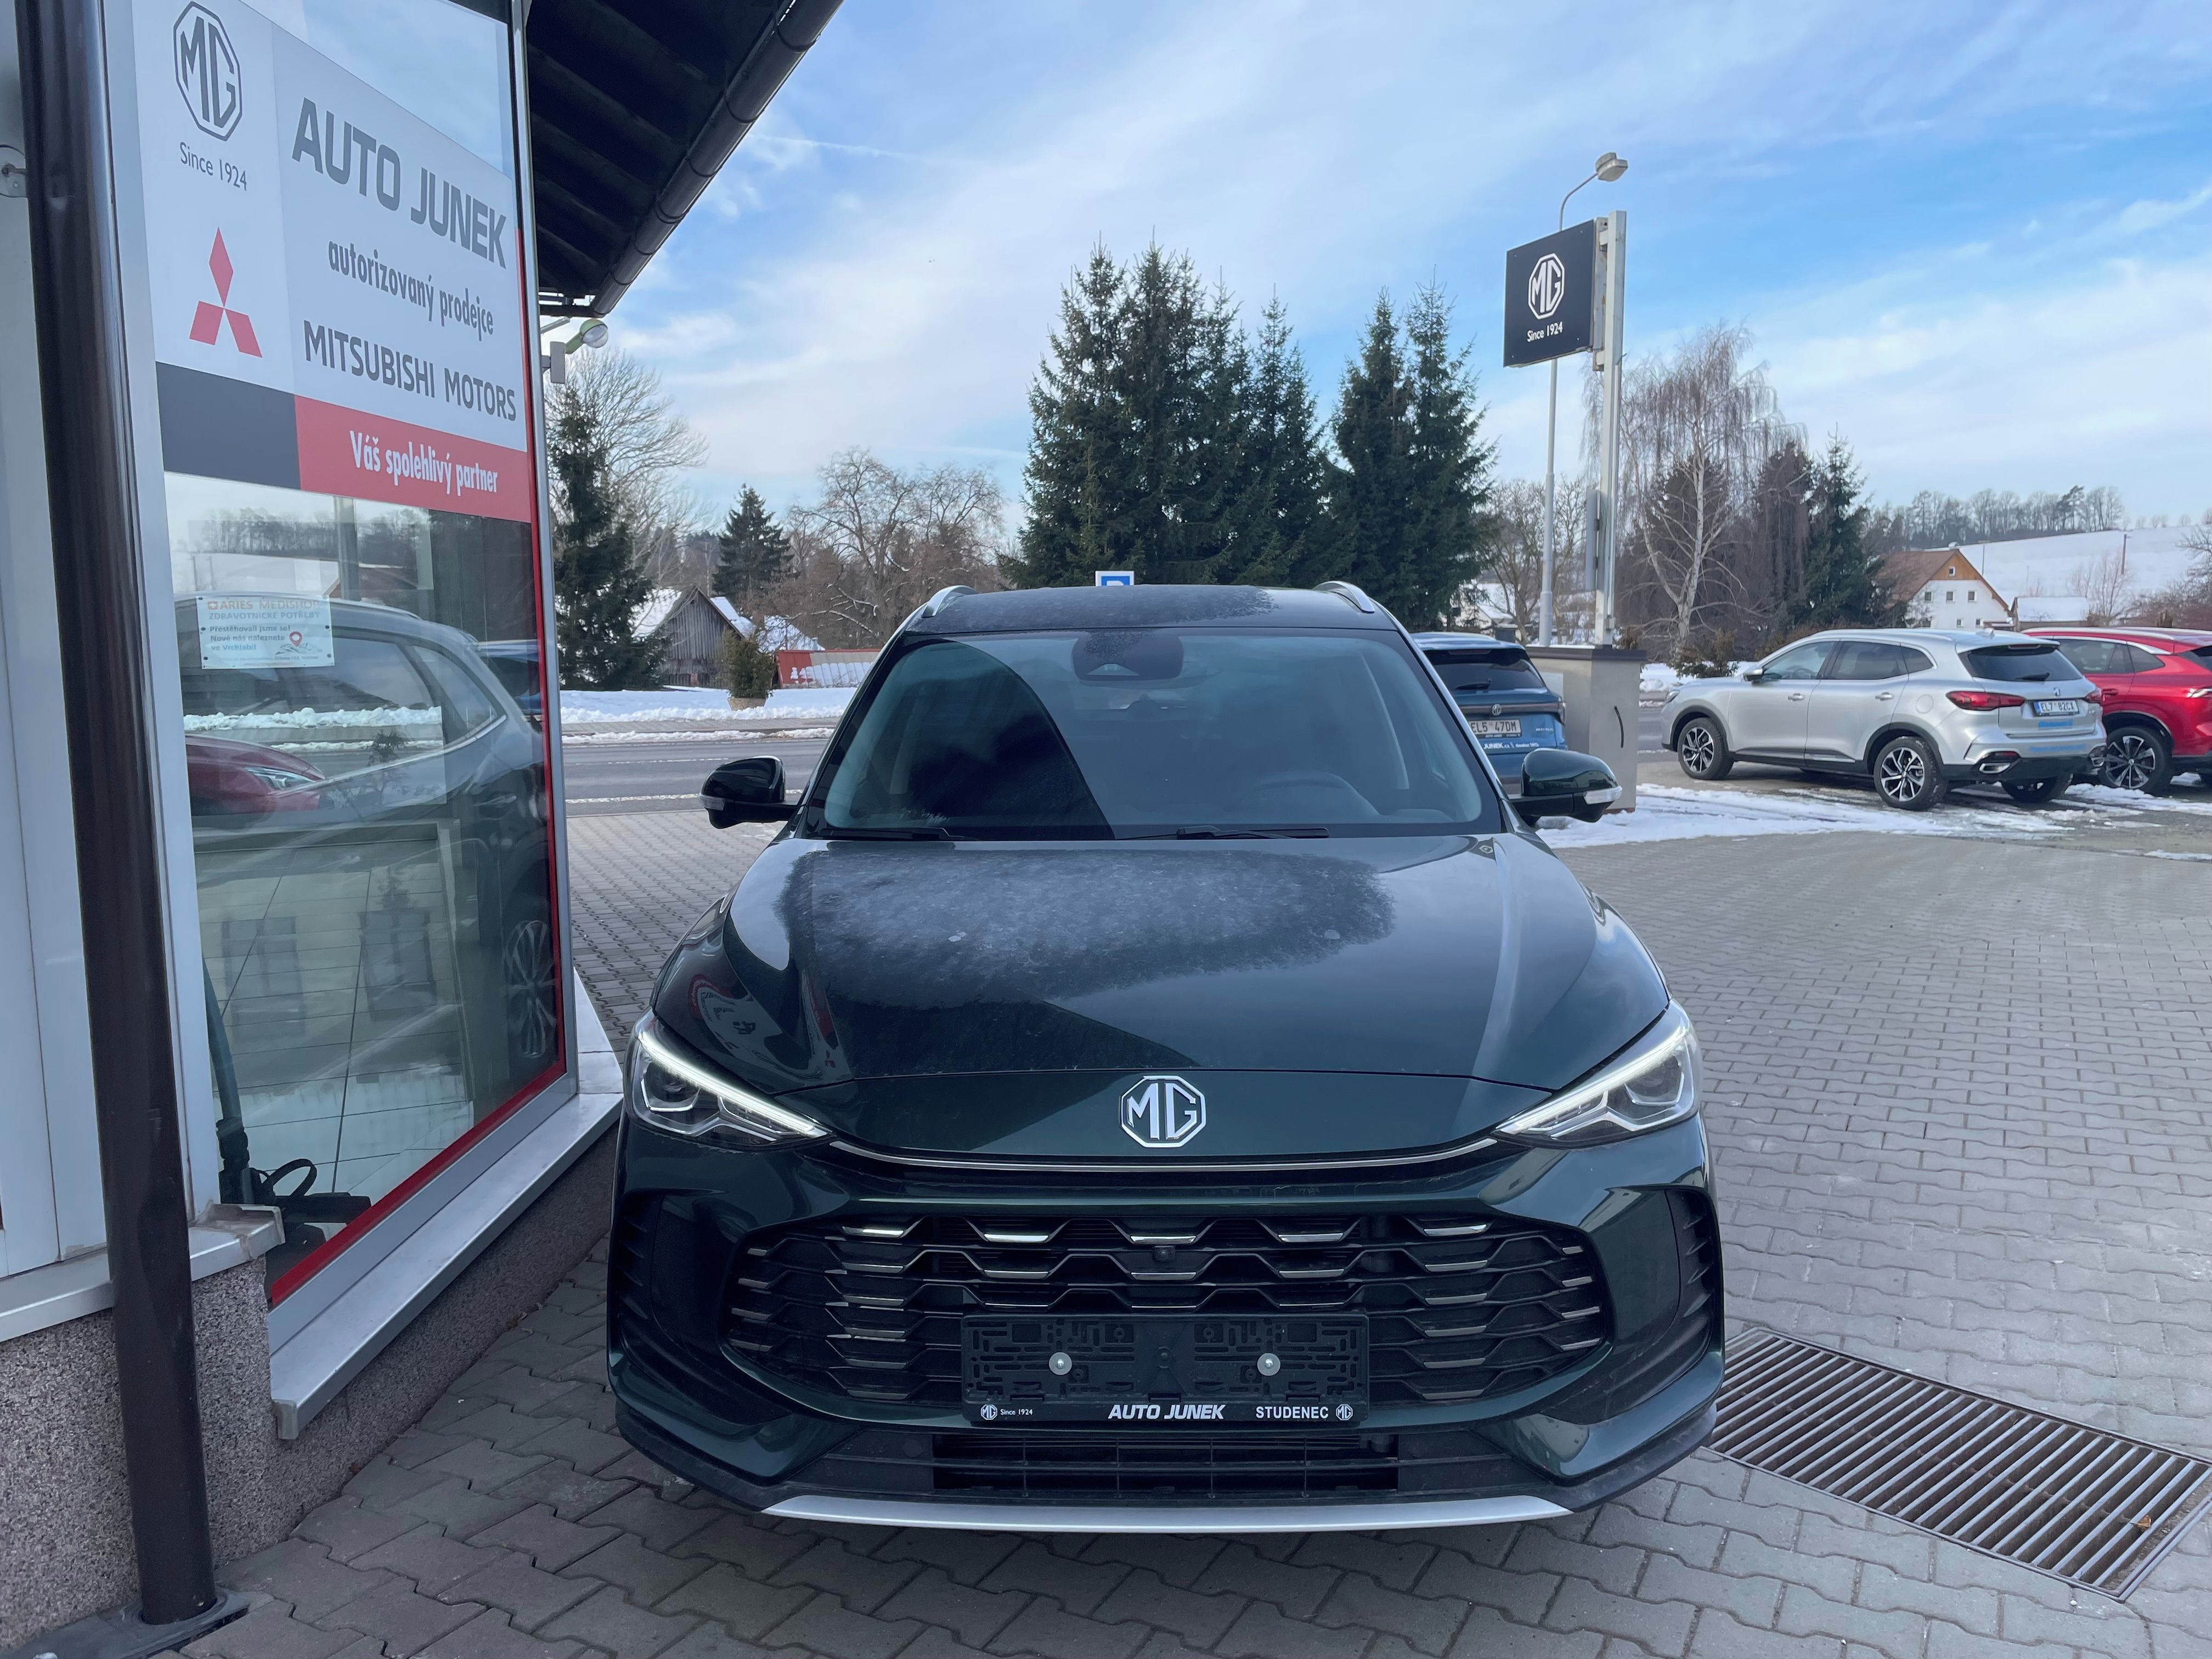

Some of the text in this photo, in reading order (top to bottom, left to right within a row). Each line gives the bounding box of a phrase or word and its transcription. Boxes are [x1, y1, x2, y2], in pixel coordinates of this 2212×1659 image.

[179, 13, 237, 130] MG
[179, 141, 247, 191] Since 1924
[291, 97, 507, 269] AUTO JUNEK
[329, 240, 494, 341] autorizovaný prodejce
[1531, 258, 1562, 315] MG
[1527, 321, 1563, 342] Since 1924
[303, 320, 517, 421] MITSUBISHI MOTORS
[349, 431, 498, 496] Váš spolehlivý partner
[219, 601, 253, 610] ARIES
[1470, 721, 1517, 733] EL5 47DM
[1125, 1081, 1199, 1142] MG
[981, 1404, 997, 1420] MG
[1108, 1404, 1353, 1420] AUTO JUNEK STUDENEC MG
